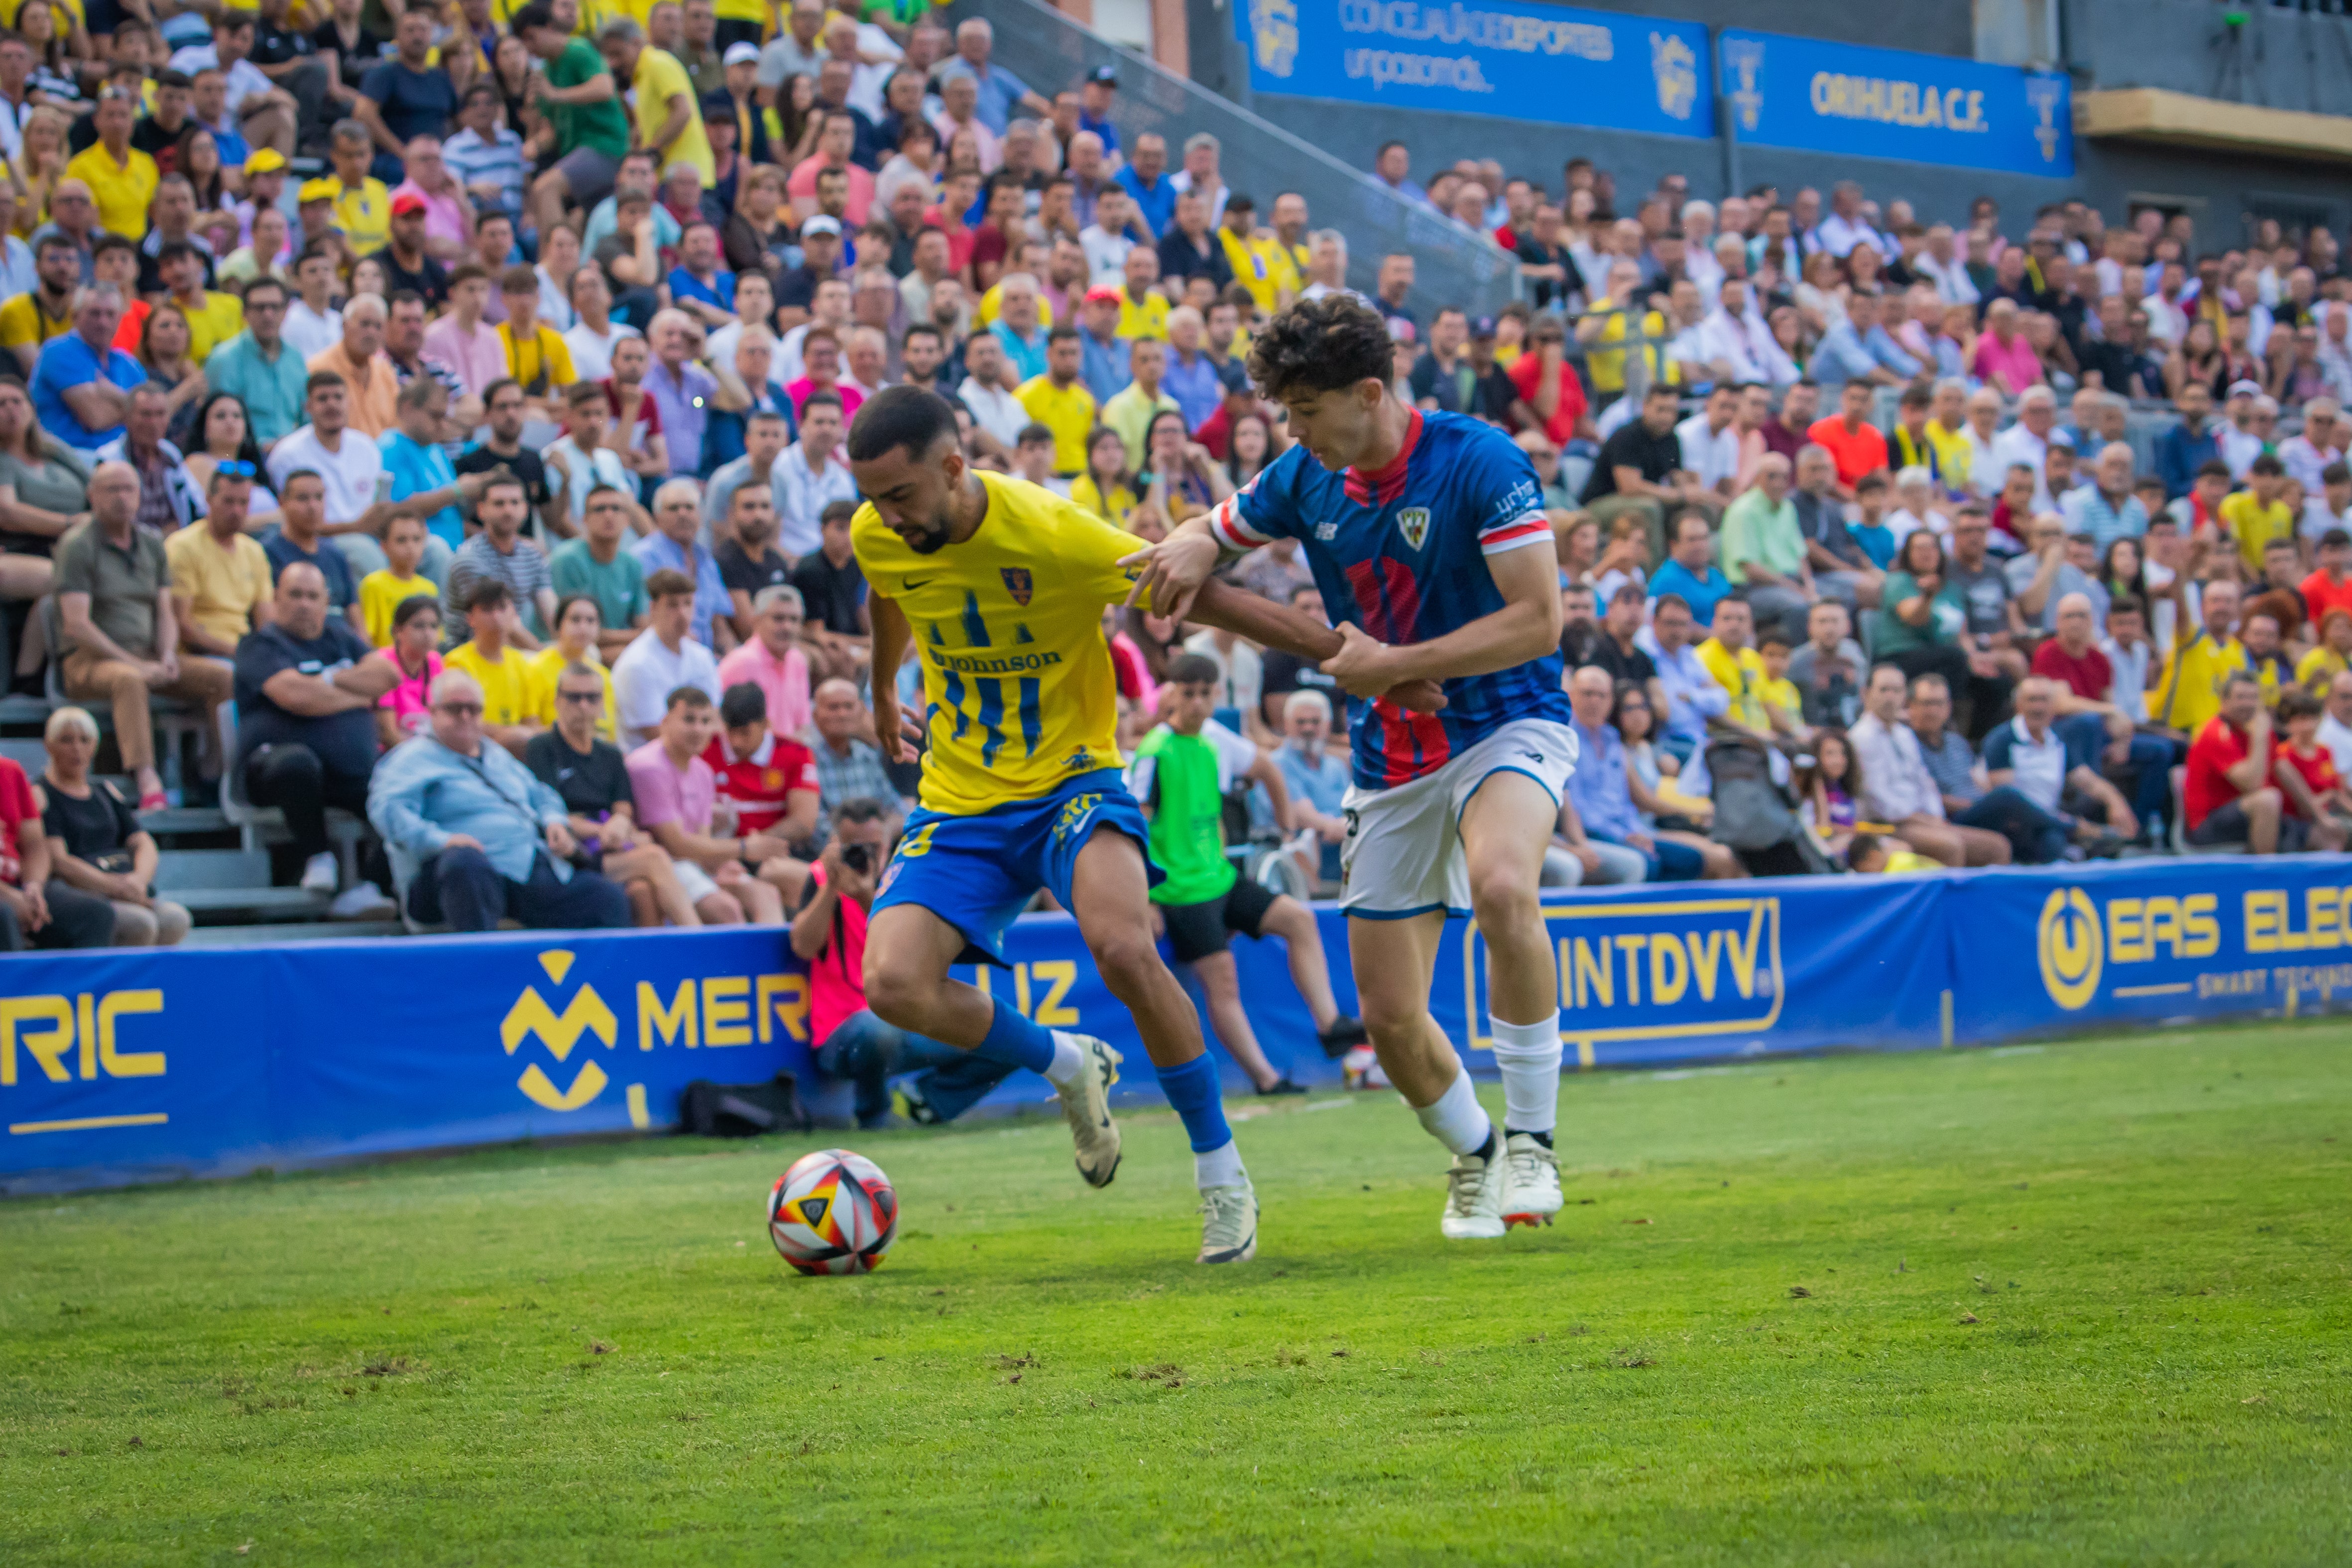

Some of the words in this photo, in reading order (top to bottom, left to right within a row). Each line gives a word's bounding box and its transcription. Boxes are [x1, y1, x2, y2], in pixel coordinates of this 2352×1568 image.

[1809, 71, 1943, 128] ORIHUELA
[2108, 893, 2221, 964] EAS
[2243, 886, 2352, 954] ELE
